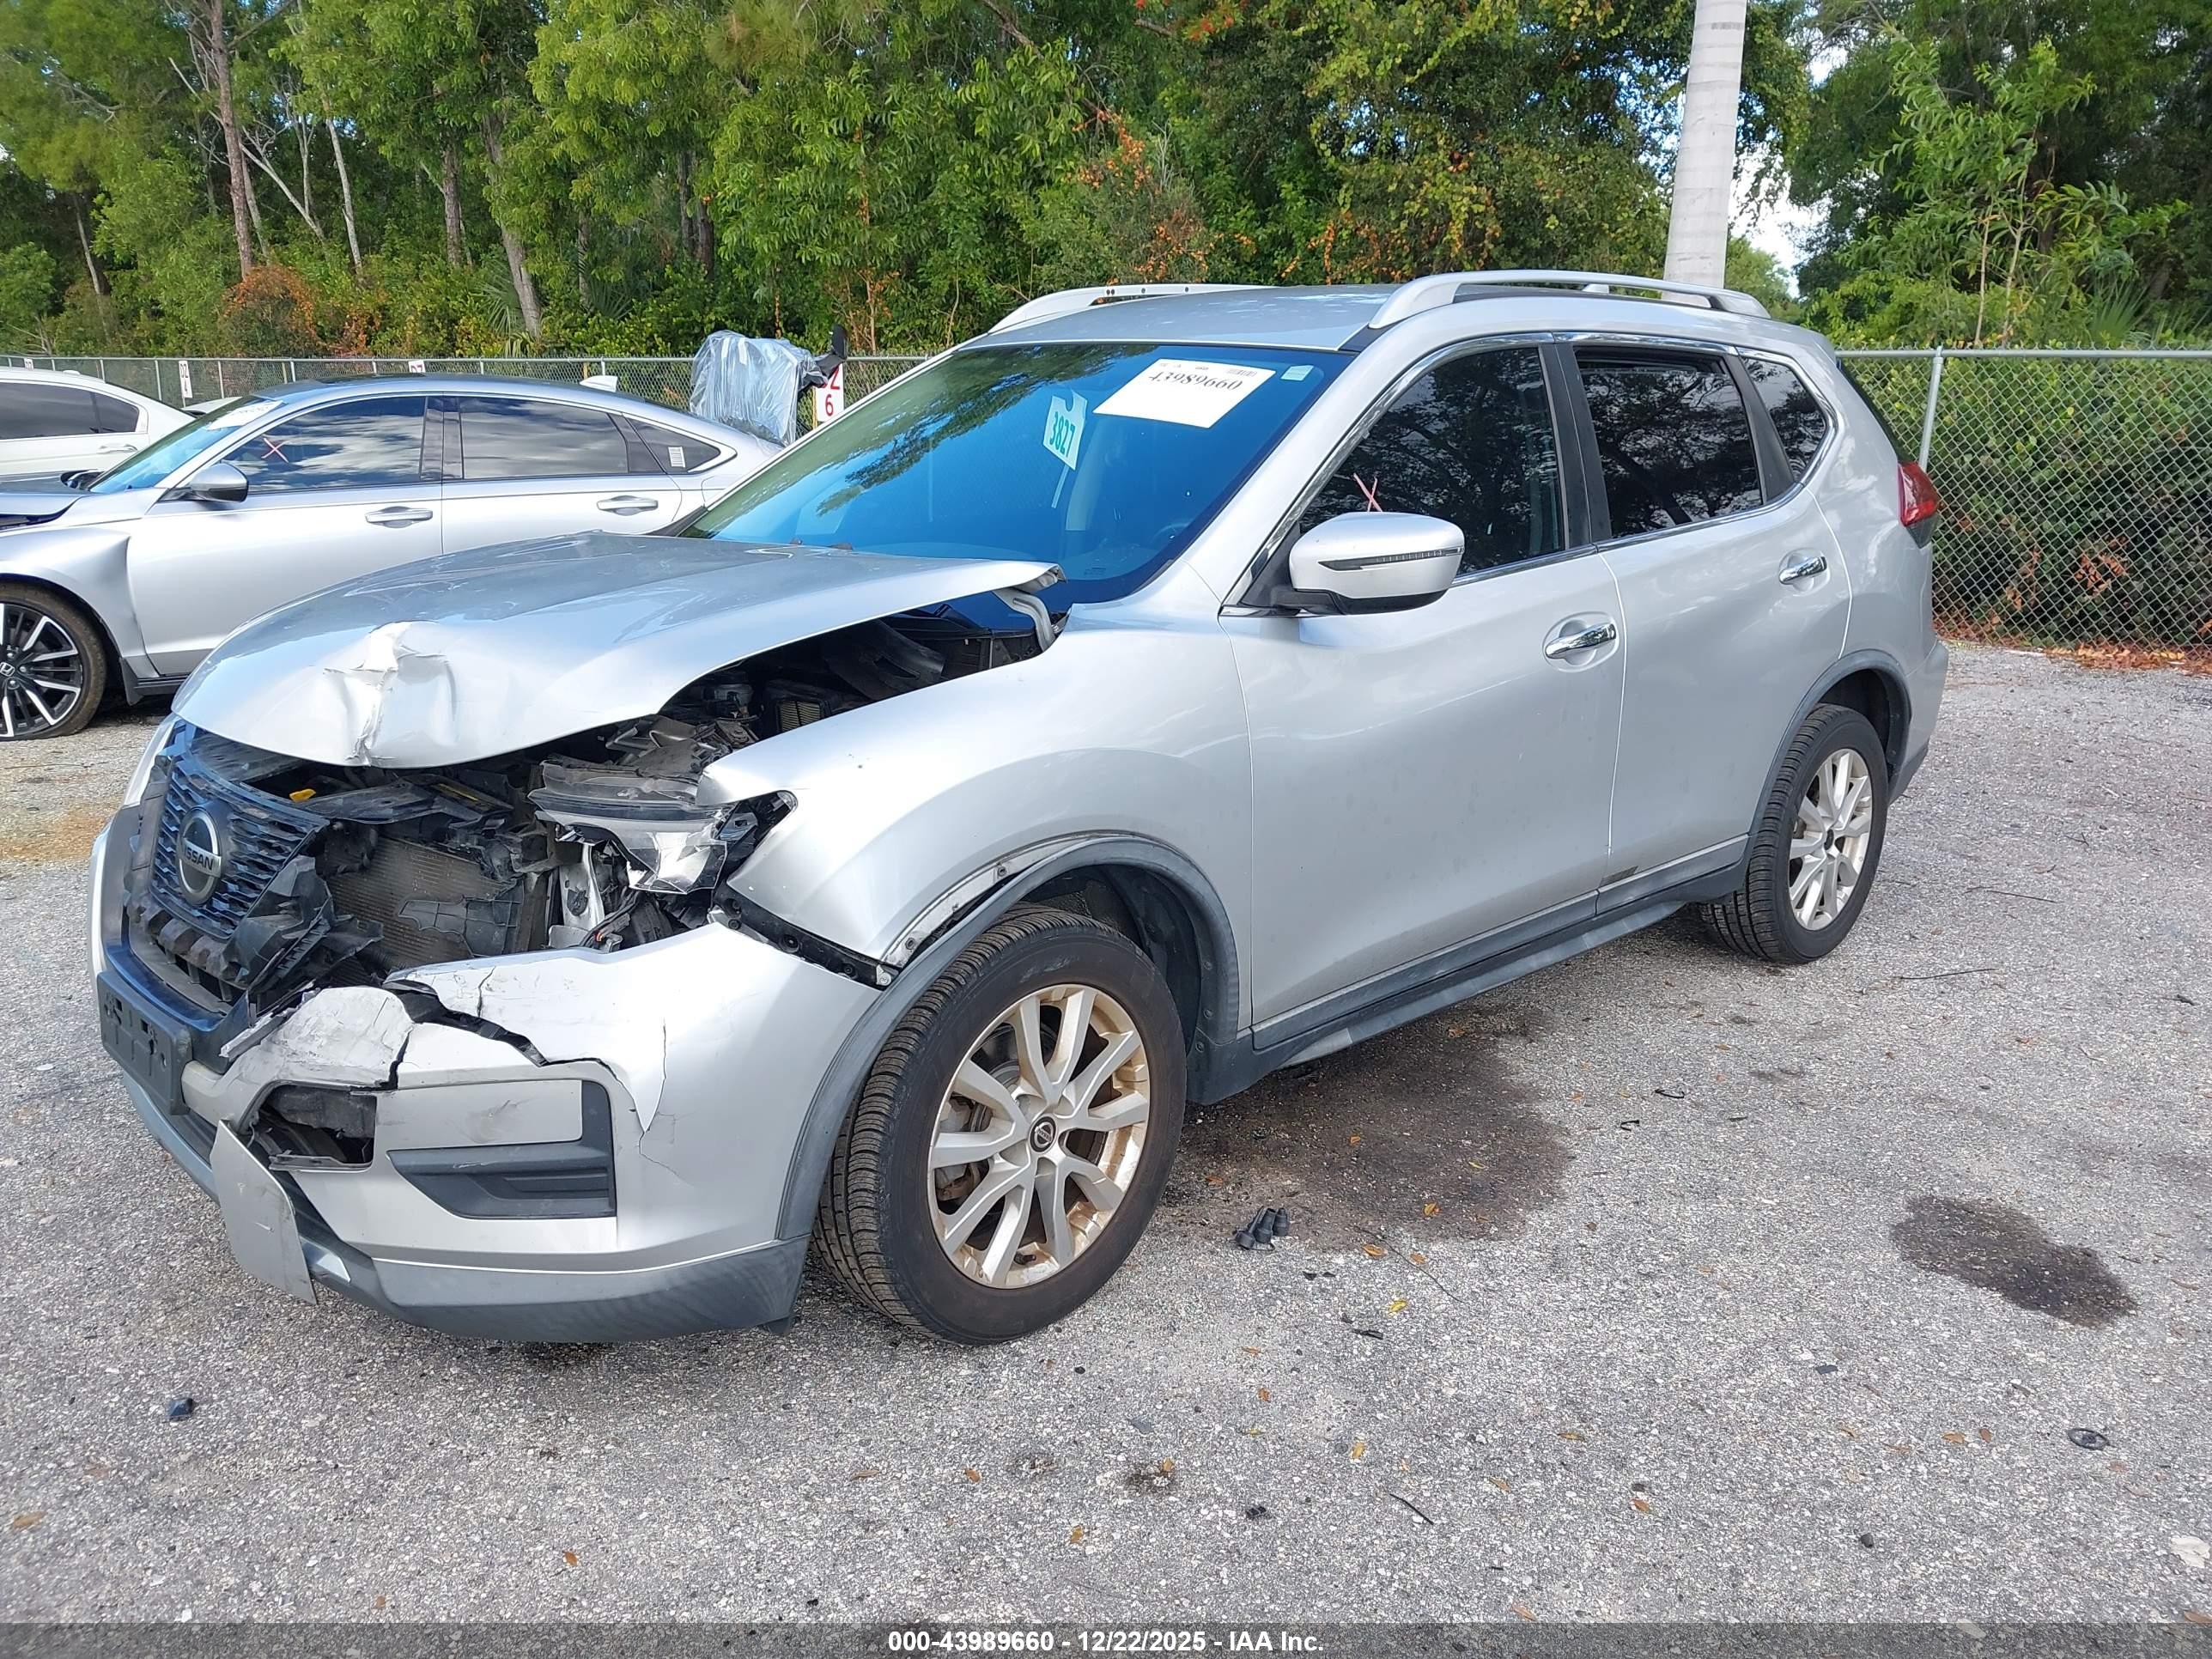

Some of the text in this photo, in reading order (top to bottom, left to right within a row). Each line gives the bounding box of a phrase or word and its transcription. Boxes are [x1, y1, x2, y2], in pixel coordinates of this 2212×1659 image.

[824, 393, 835, 417] 6
[1049, 411, 1076, 458] 3827
[181, 842, 214, 872] ISSAN
